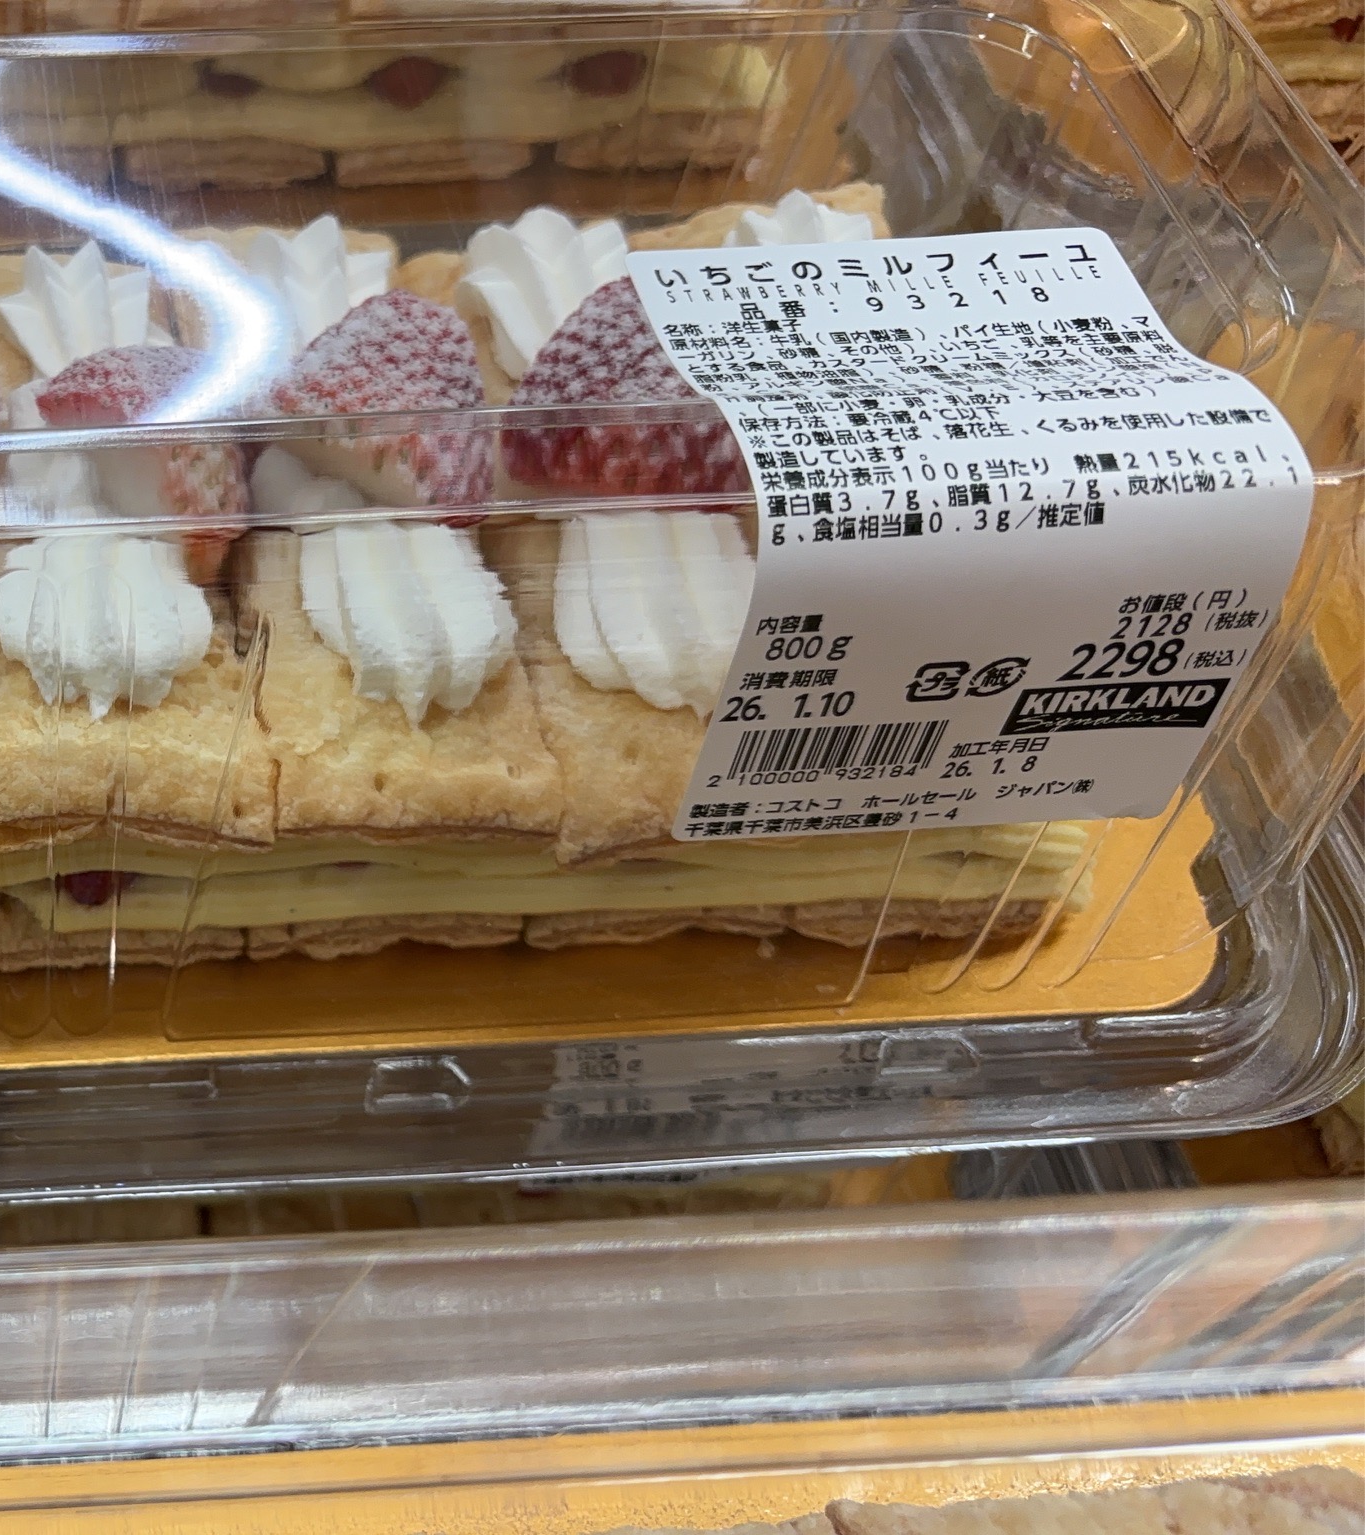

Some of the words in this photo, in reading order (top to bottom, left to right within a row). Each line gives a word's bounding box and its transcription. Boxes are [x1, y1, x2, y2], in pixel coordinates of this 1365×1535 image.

[654, 244, 1097, 287] いちごのミルフィーユ
[666, 282, 841, 304] STRAWBERRY
[867, 275, 953, 294] MILLE
[978, 265, 1101, 286] FEUILLE
[662, 319, 802, 337] 名称：洋生菓子
[753, 445, 929, 470] 製造しています。
[756, 614, 823, 636] 内容量
[1110, 613, 1192, 640] 2128
[1055, 639, 1185, 682] 2298
[739, 668, 838, 691] 消費期限
[1019, 684, 1216, 716] KIRKLAND
[1013, 711, 1197, 733] Signature
[948, 737, 1050, 759] 加工年月日
[706, 775, 721, 788] 2
[738, 770, 820, 787] 100000
[835, 764, 918, 781] 932184
[861, 787, 977, 809] ホールセール
